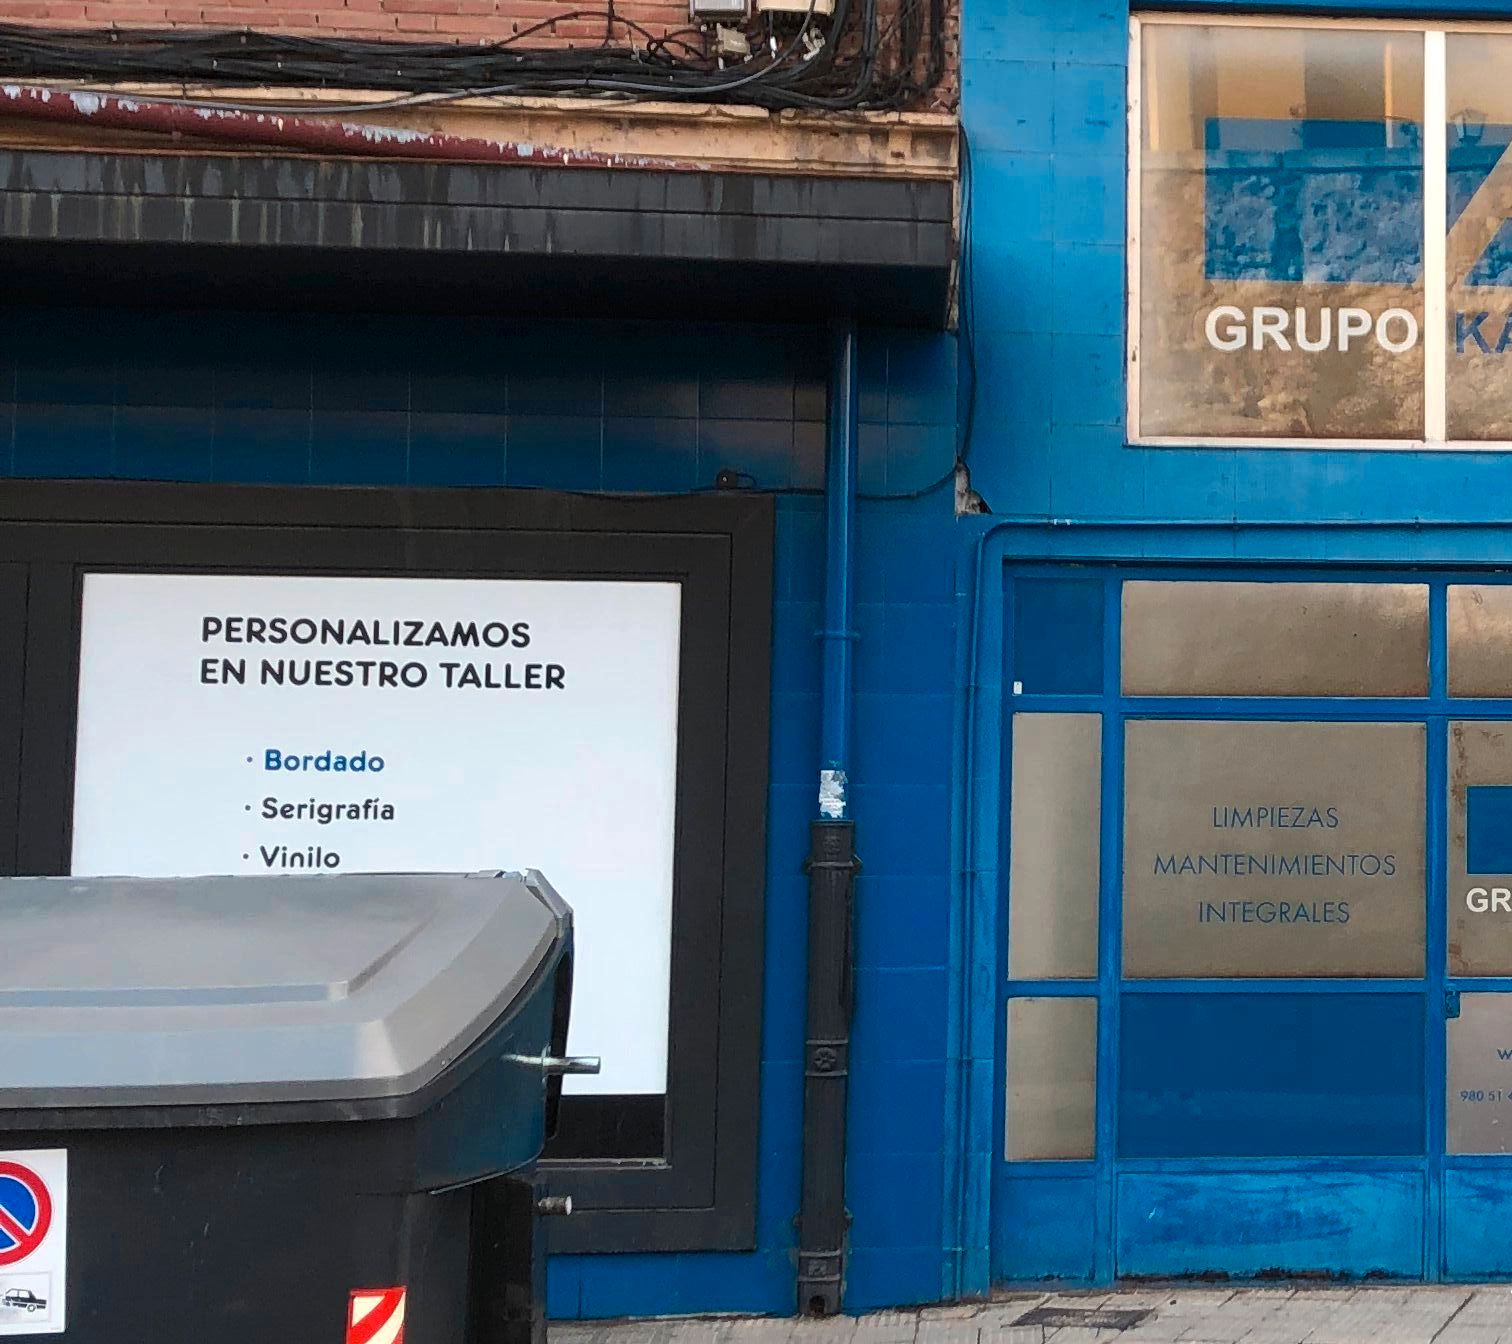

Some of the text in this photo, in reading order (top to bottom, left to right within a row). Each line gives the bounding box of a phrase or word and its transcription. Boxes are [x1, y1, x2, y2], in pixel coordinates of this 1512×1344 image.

[1205, 305, 1419, 353] GRUPO
[201, 615, 531, 649] PERSONALIZAMOS
[199, 658, 566, 691] EN NUESTRO TALLER
[263, 748, 386, 774] Bordado
[260, 796, 396, 825] Serigrafía
[1212, 806, 1340, 830] LIMPIEZAS
[259, 845, 342, 870] Vinilo
[1153, 853, 1397, 877] MANTENIMIENTOS
[1199, 900, 1351, 924] INTEGRALES
[1460, 1089, 1485, 1101] 980
